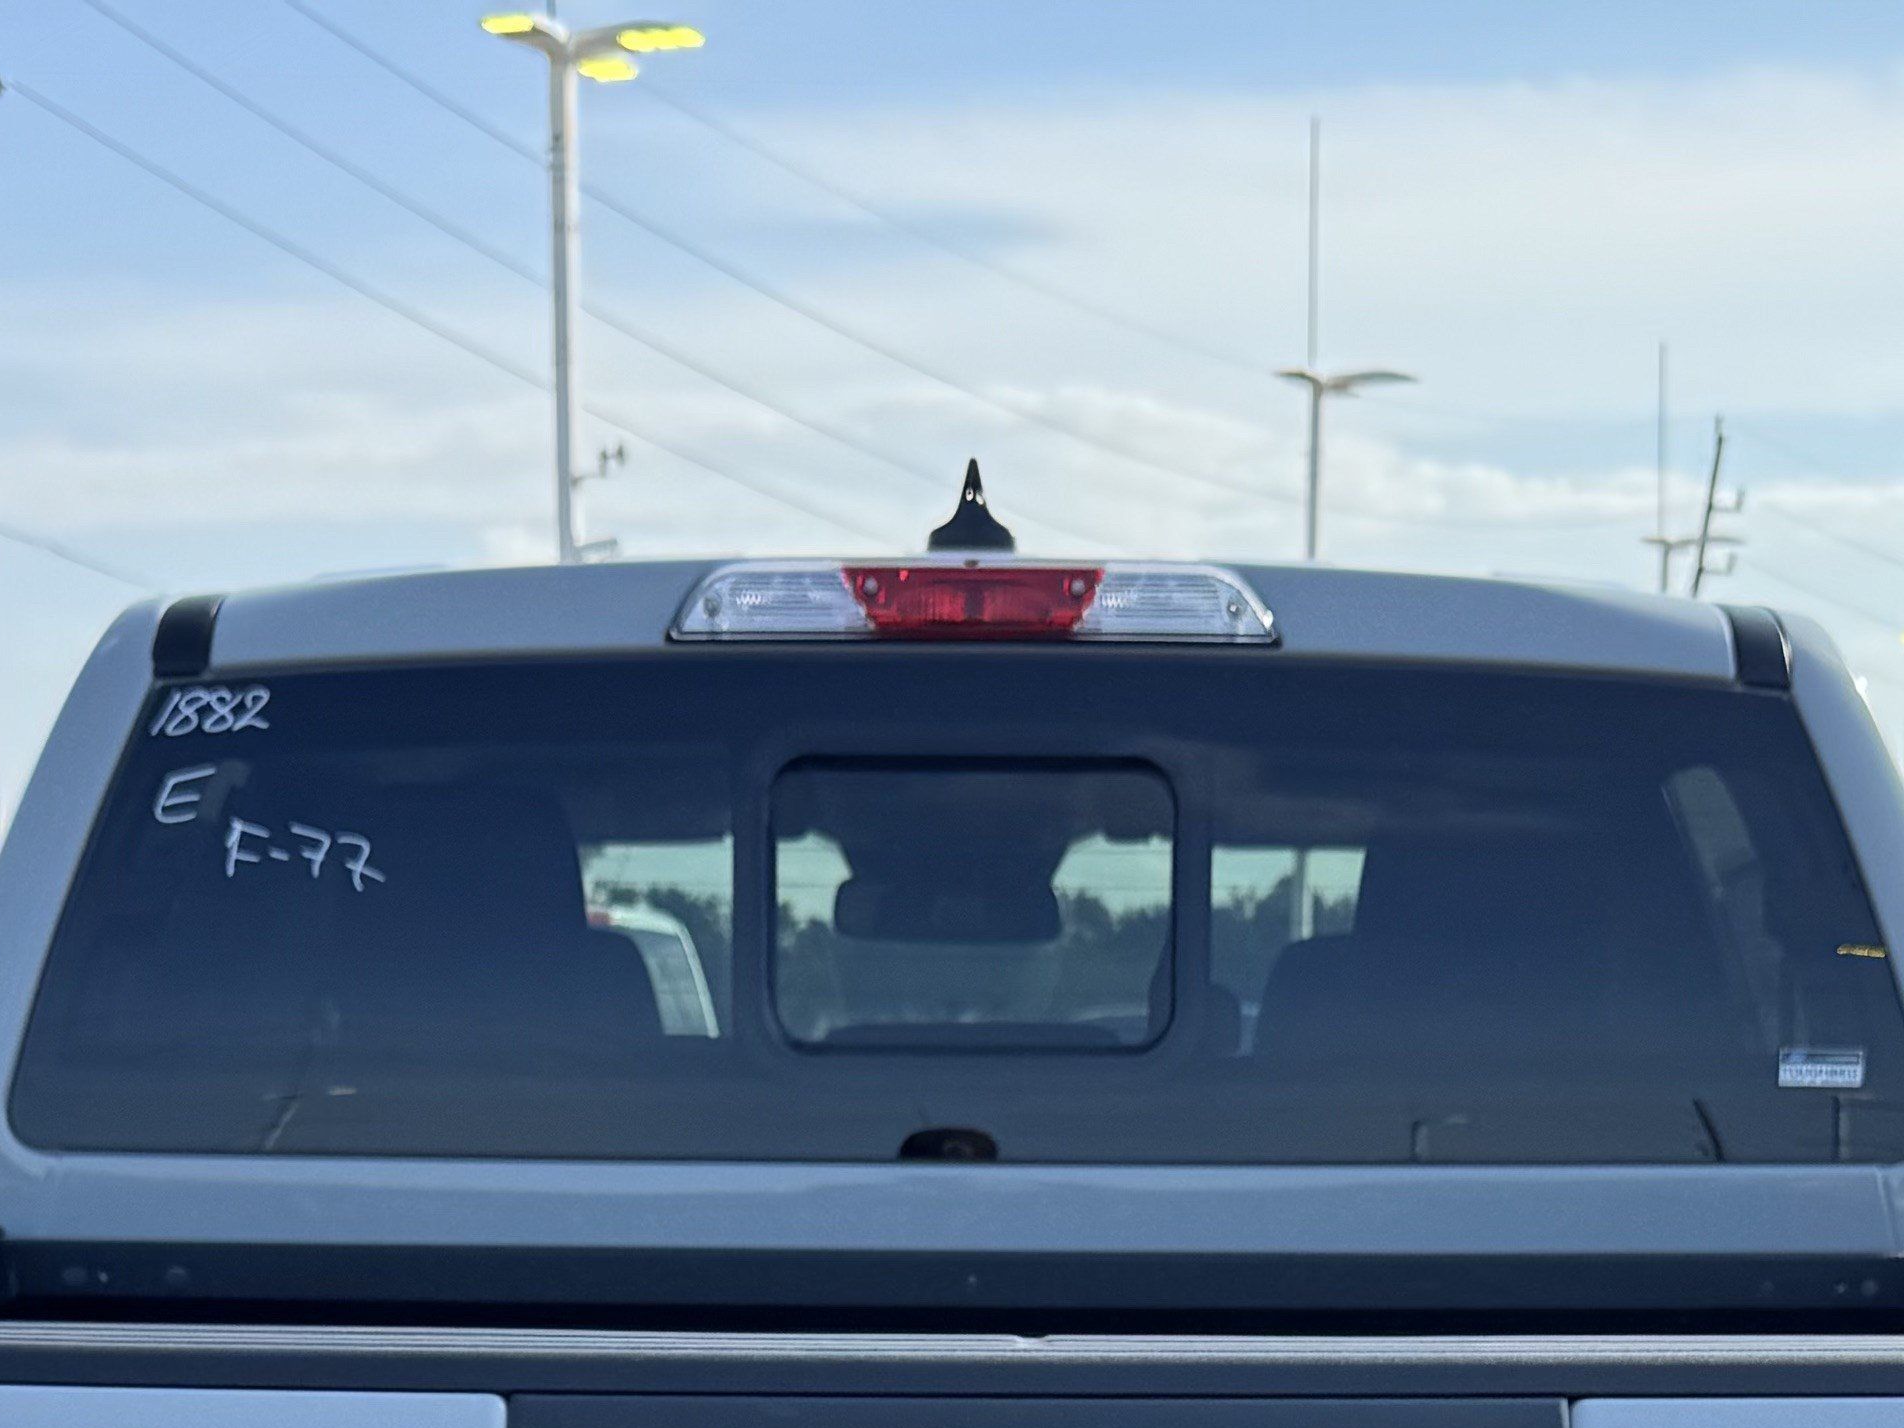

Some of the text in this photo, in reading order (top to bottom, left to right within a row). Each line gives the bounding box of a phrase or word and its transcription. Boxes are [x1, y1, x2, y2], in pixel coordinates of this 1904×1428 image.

[150, 684, 271, 737] 1882
[153, 764, 217, 824] E
[225, 817, 387, 892] F-77
